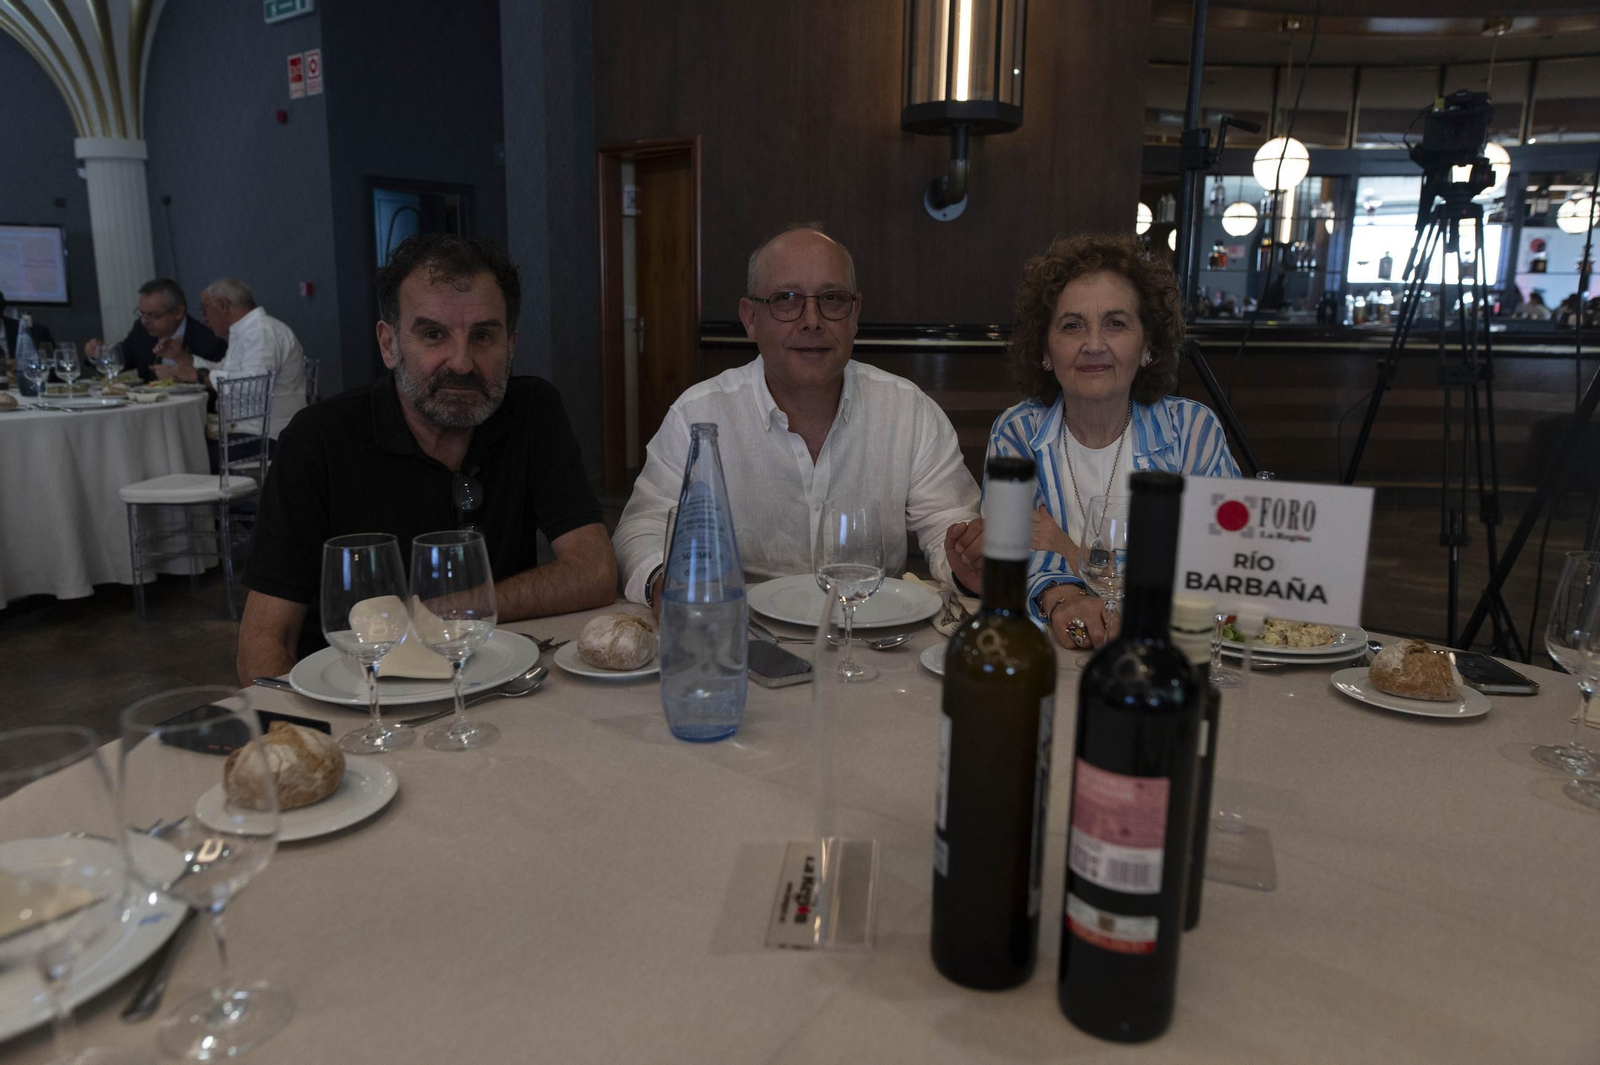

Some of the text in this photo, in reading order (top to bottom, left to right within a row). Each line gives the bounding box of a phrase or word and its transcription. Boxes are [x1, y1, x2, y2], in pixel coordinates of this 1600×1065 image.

[1259, 497, 1316, 532] FORO
[1260, 531, 1274, 539] La
[1234, 551, 1274, 571] RÍO
[1186, 572, 1327, 604] BARBAÑA
